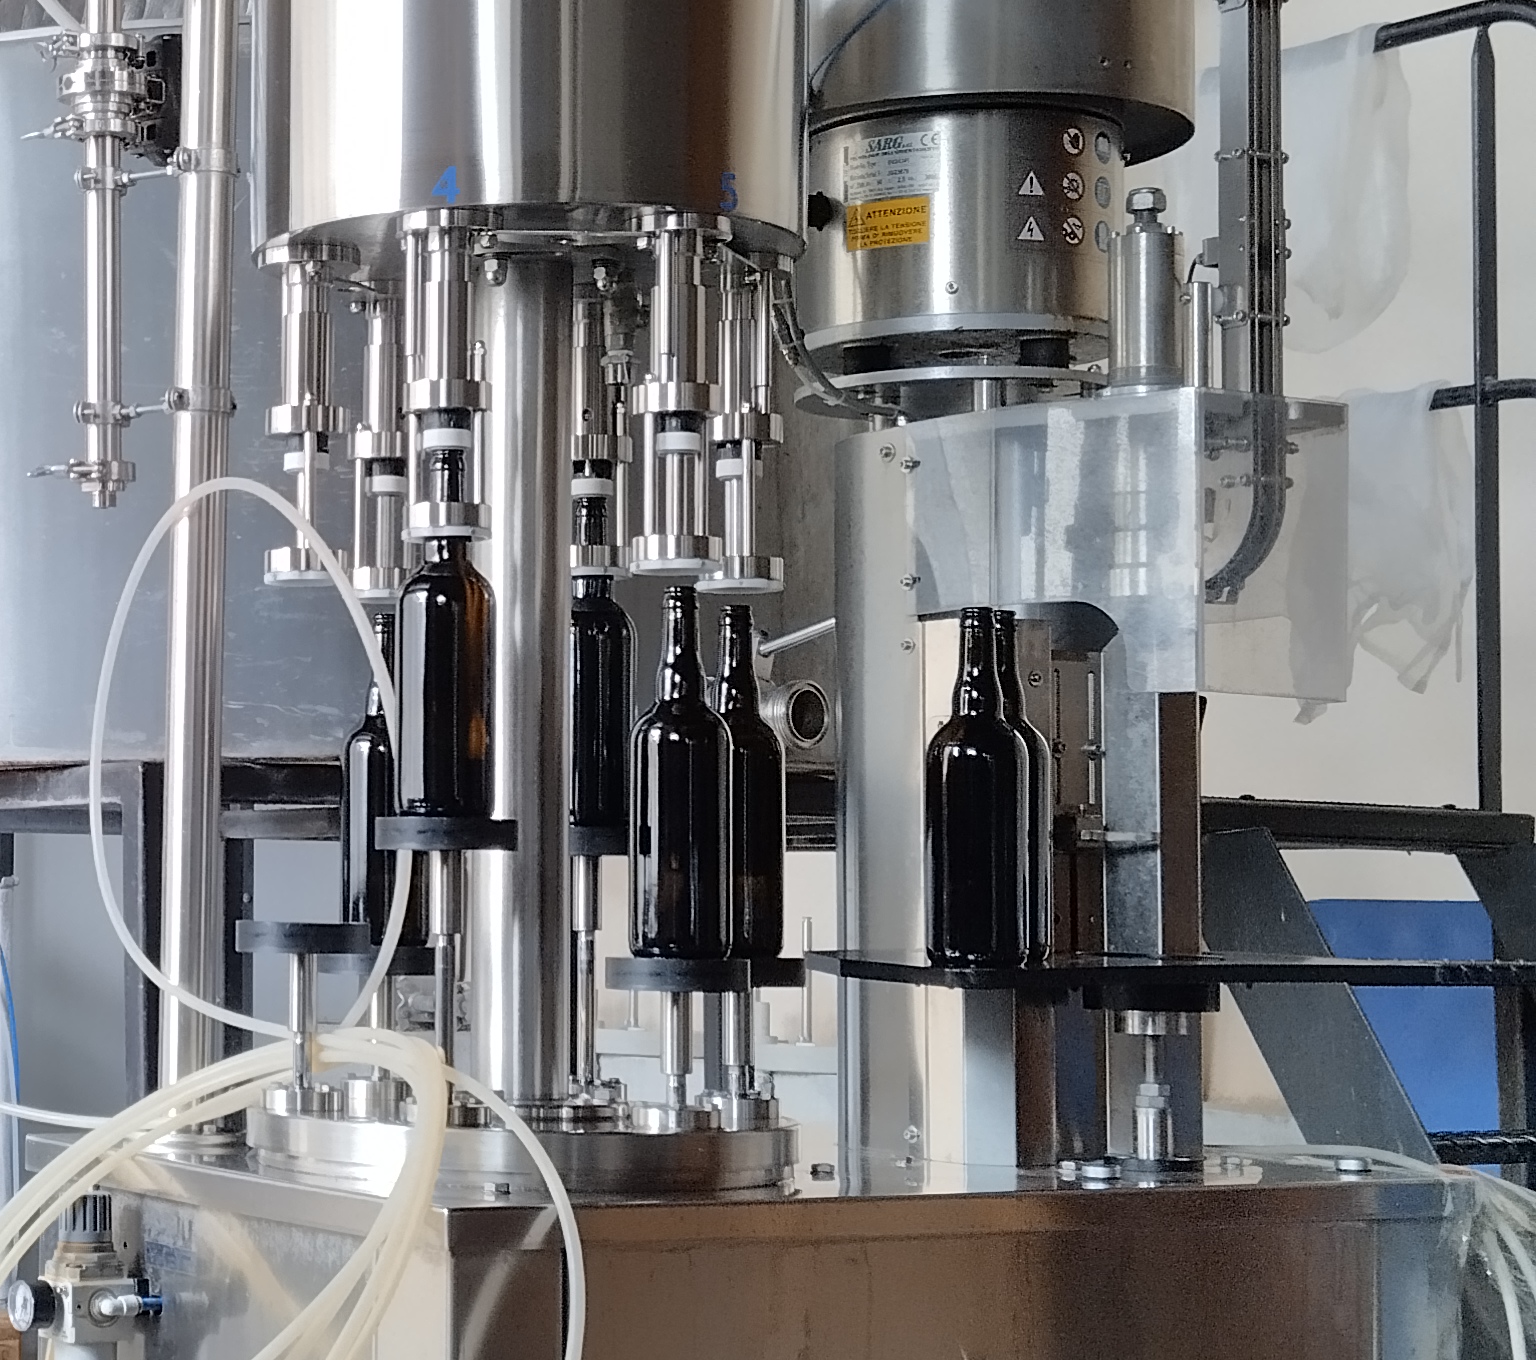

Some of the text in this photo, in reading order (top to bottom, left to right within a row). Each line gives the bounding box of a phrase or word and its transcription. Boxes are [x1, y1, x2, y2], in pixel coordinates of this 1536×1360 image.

[431, 165, 461, 204] 4
[719, 172, 738, 212] 5
[865, 205, 927, 219] ATTENZIONE
